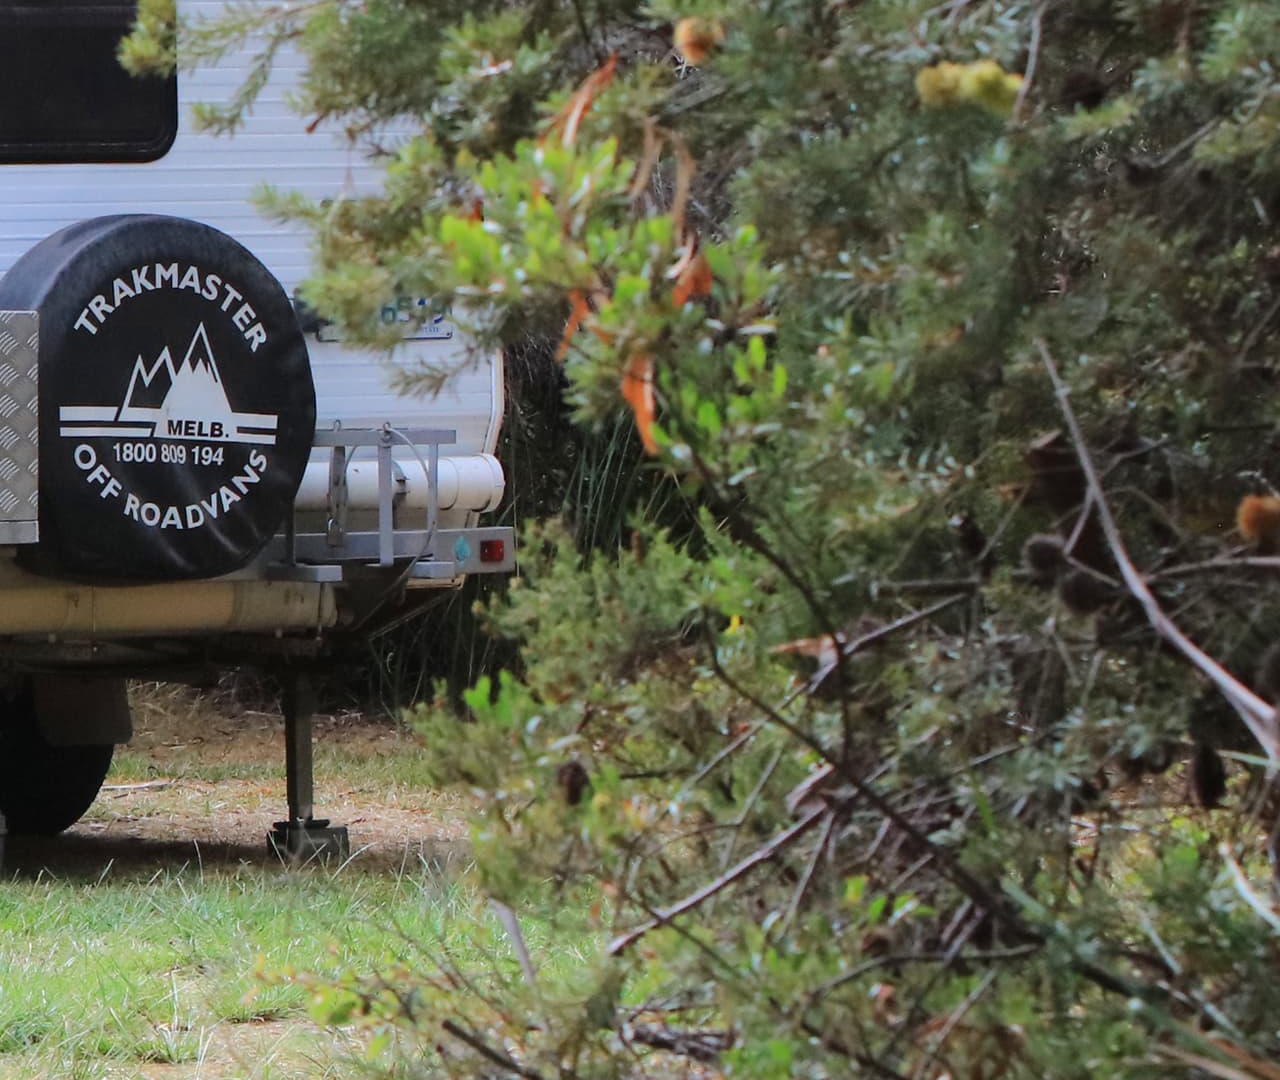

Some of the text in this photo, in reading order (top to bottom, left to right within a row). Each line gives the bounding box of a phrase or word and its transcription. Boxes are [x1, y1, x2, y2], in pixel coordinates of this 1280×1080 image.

[74, 263, 268, 353] TRAKMASTER
[167, 419, 230, 438] MELB.
[74, 443, 123, 501] OFF
[112, 442, 225, 467] 1800 809 194
